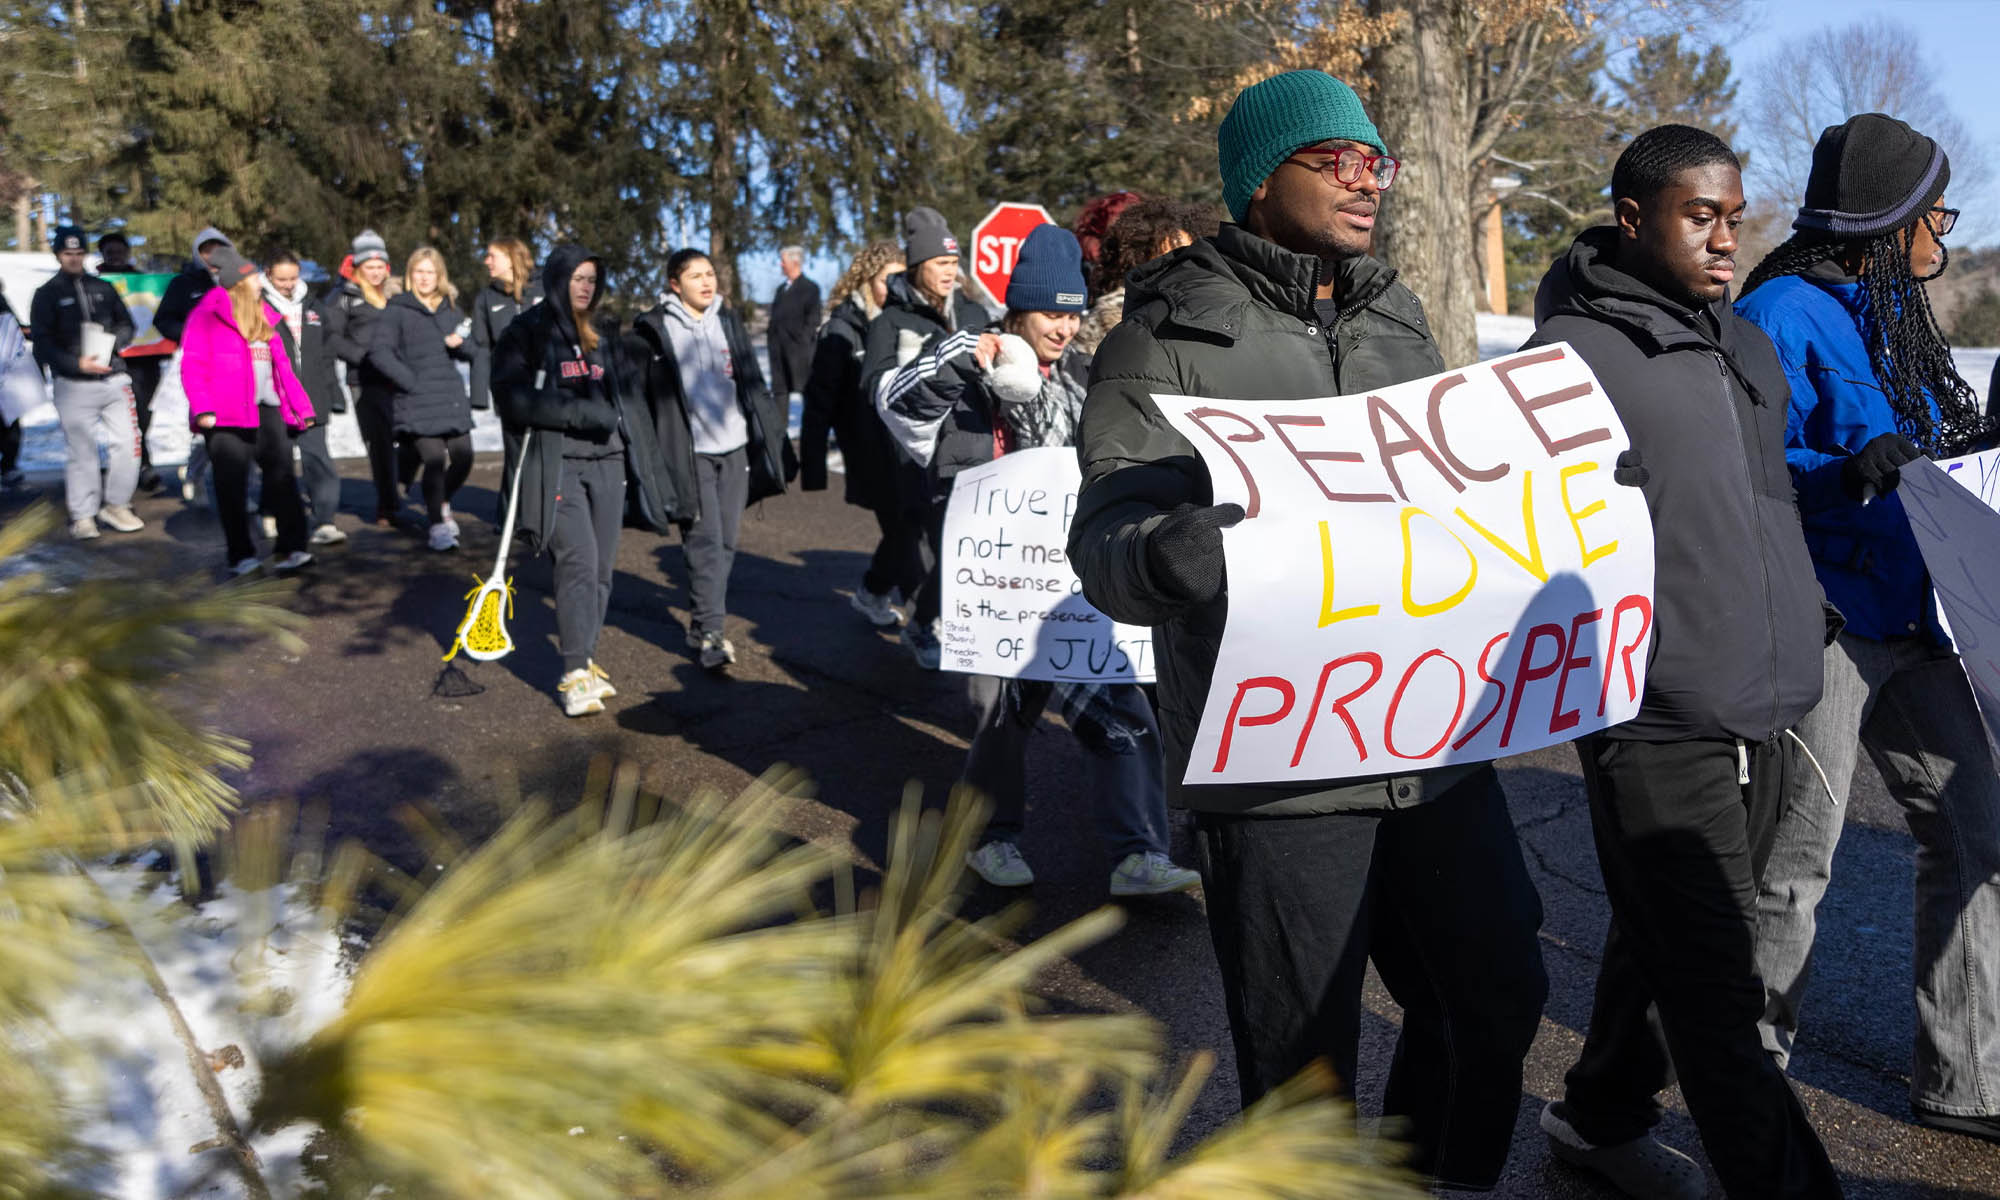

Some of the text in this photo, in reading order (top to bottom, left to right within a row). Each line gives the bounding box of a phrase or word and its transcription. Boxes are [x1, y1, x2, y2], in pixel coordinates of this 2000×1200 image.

[979, 235, 1026, 274] ST
[1184, 348, 1612, 519] PEACE
[964, 473, 1078, 533] True p
[958, 527, 1067, 565] not me
[1317, 462, 1619, 628] LOVE
[956, 567, 1083, 596] absense o
[956, 599, 1101, 625] is the presence
[1050, 638, 1155, 675] JUST
[1212, 594, 1652, 773] PROSPER
